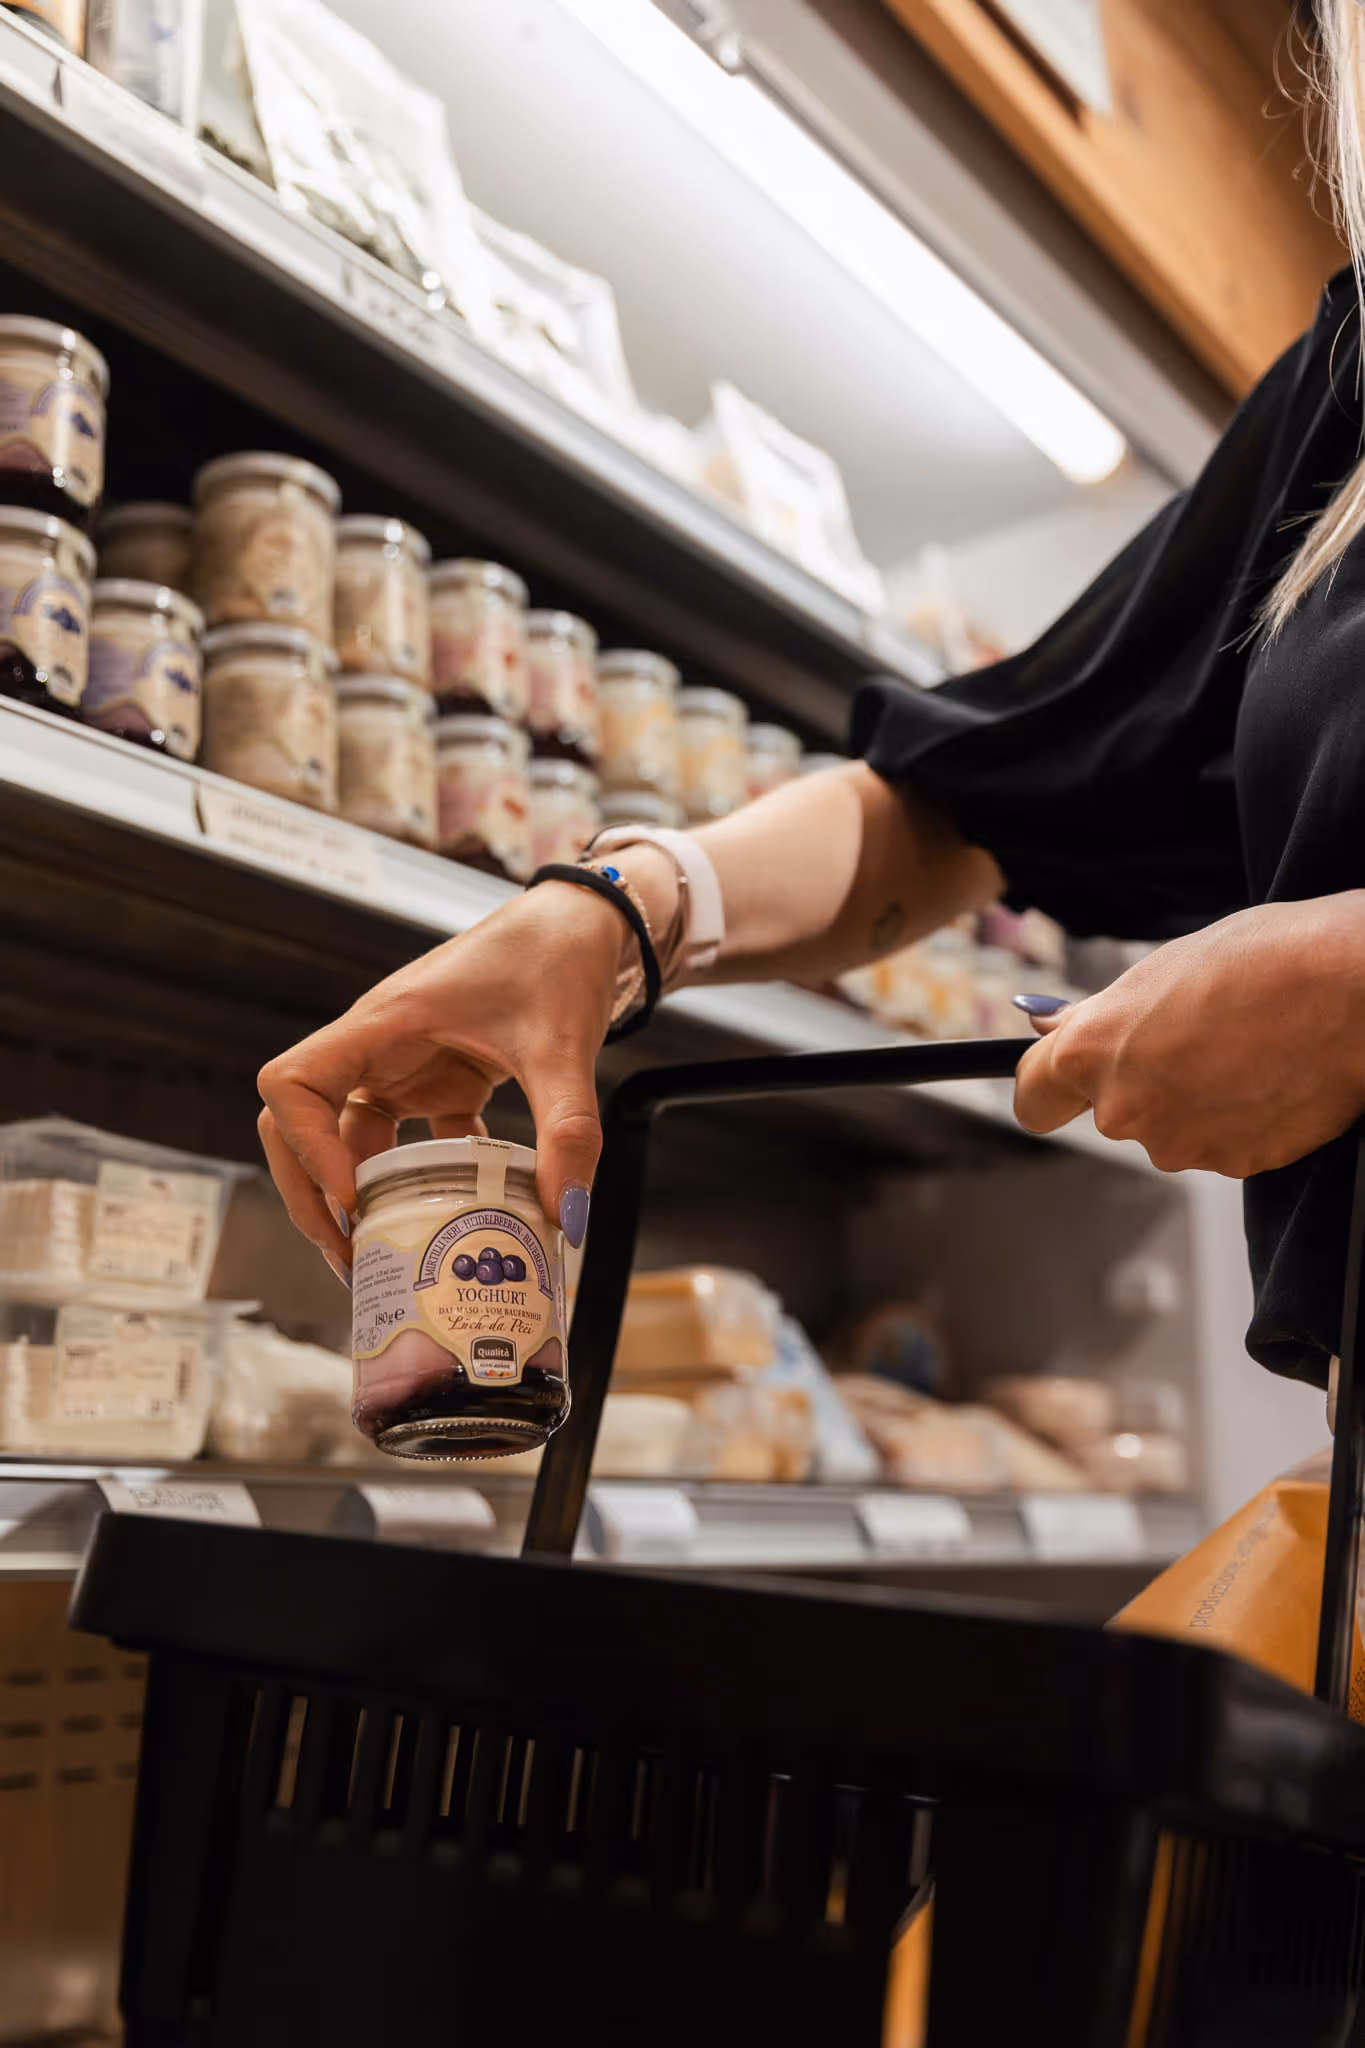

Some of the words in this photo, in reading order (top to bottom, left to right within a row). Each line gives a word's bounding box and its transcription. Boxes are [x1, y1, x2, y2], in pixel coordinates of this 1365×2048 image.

[425, 1236, 446, 1276] MIRTILLI
[441, 1224, 462, 1243] NERI
[464, 1214, 522, 1237] HEIDELBEEREN
[456, 1287, 527, 1305] YOGHURT
[478, 1347, 510, 1358] Qualità
